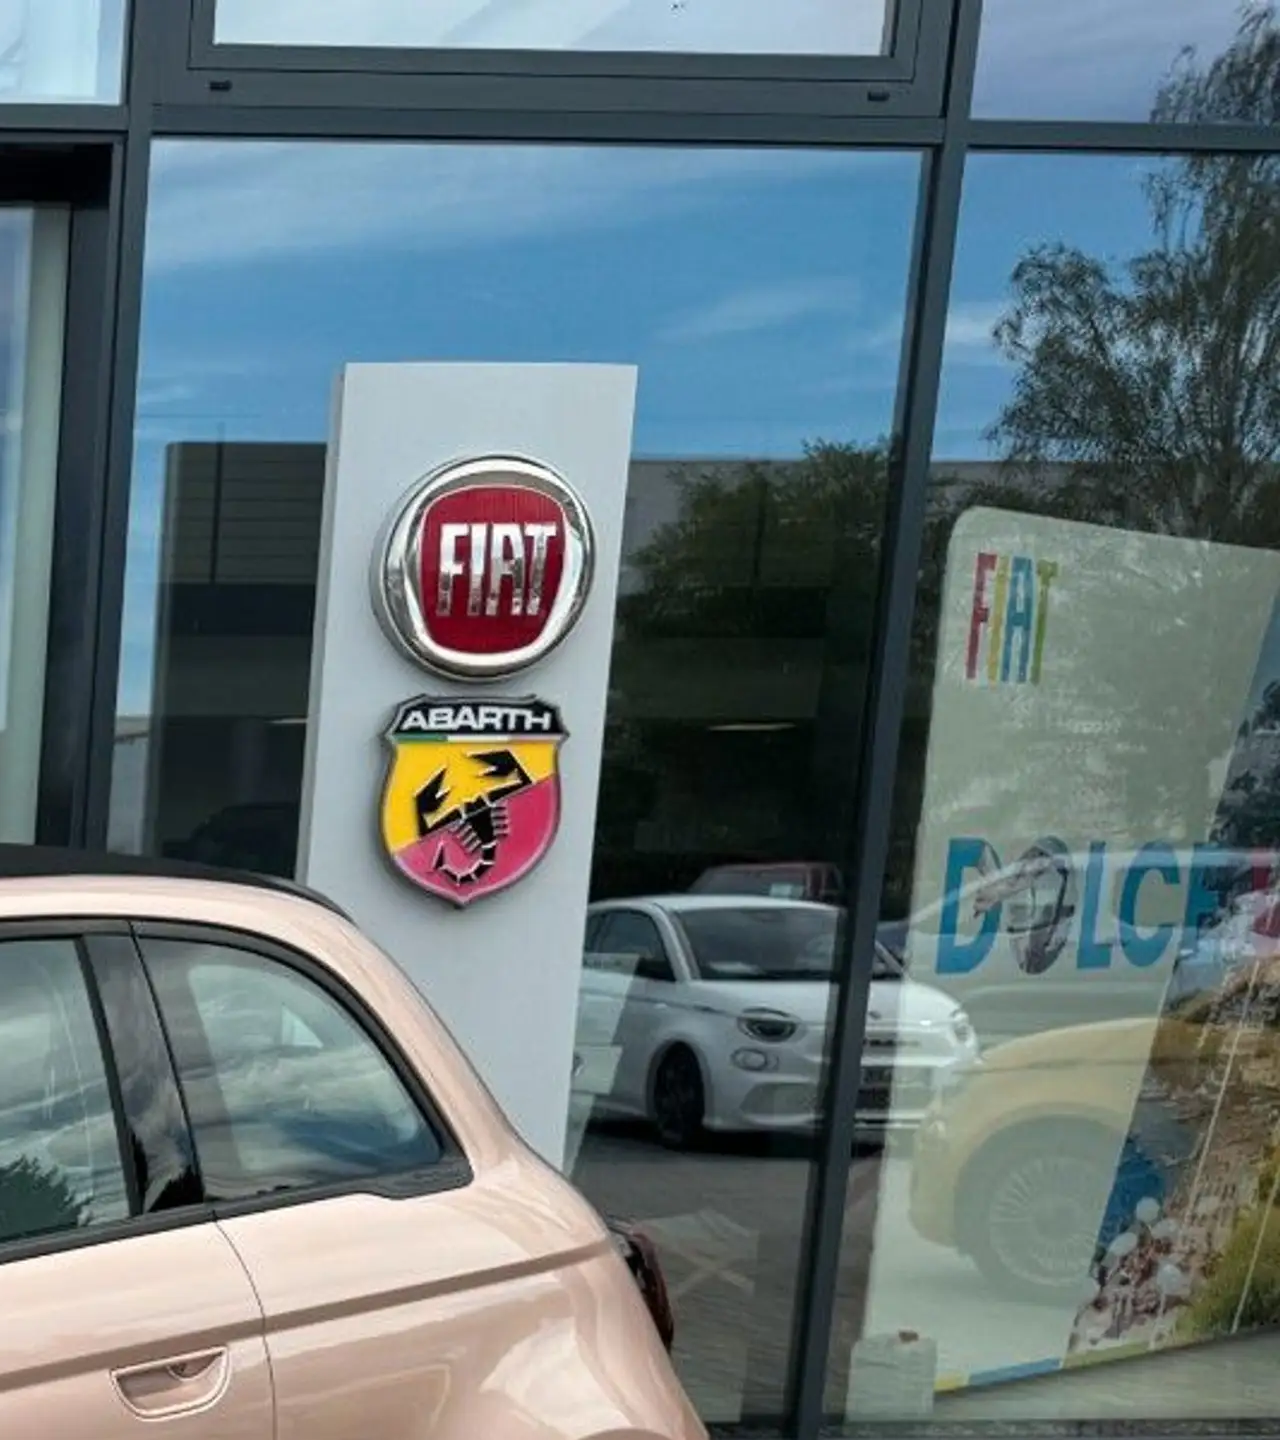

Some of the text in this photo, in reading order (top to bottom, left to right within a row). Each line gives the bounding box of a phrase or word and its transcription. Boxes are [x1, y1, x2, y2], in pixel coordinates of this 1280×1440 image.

[436, 522, 557, 617] FIAT
[965, 552, 1060, 687] FIAT
[401, 706, 553, 731] ABARTH
